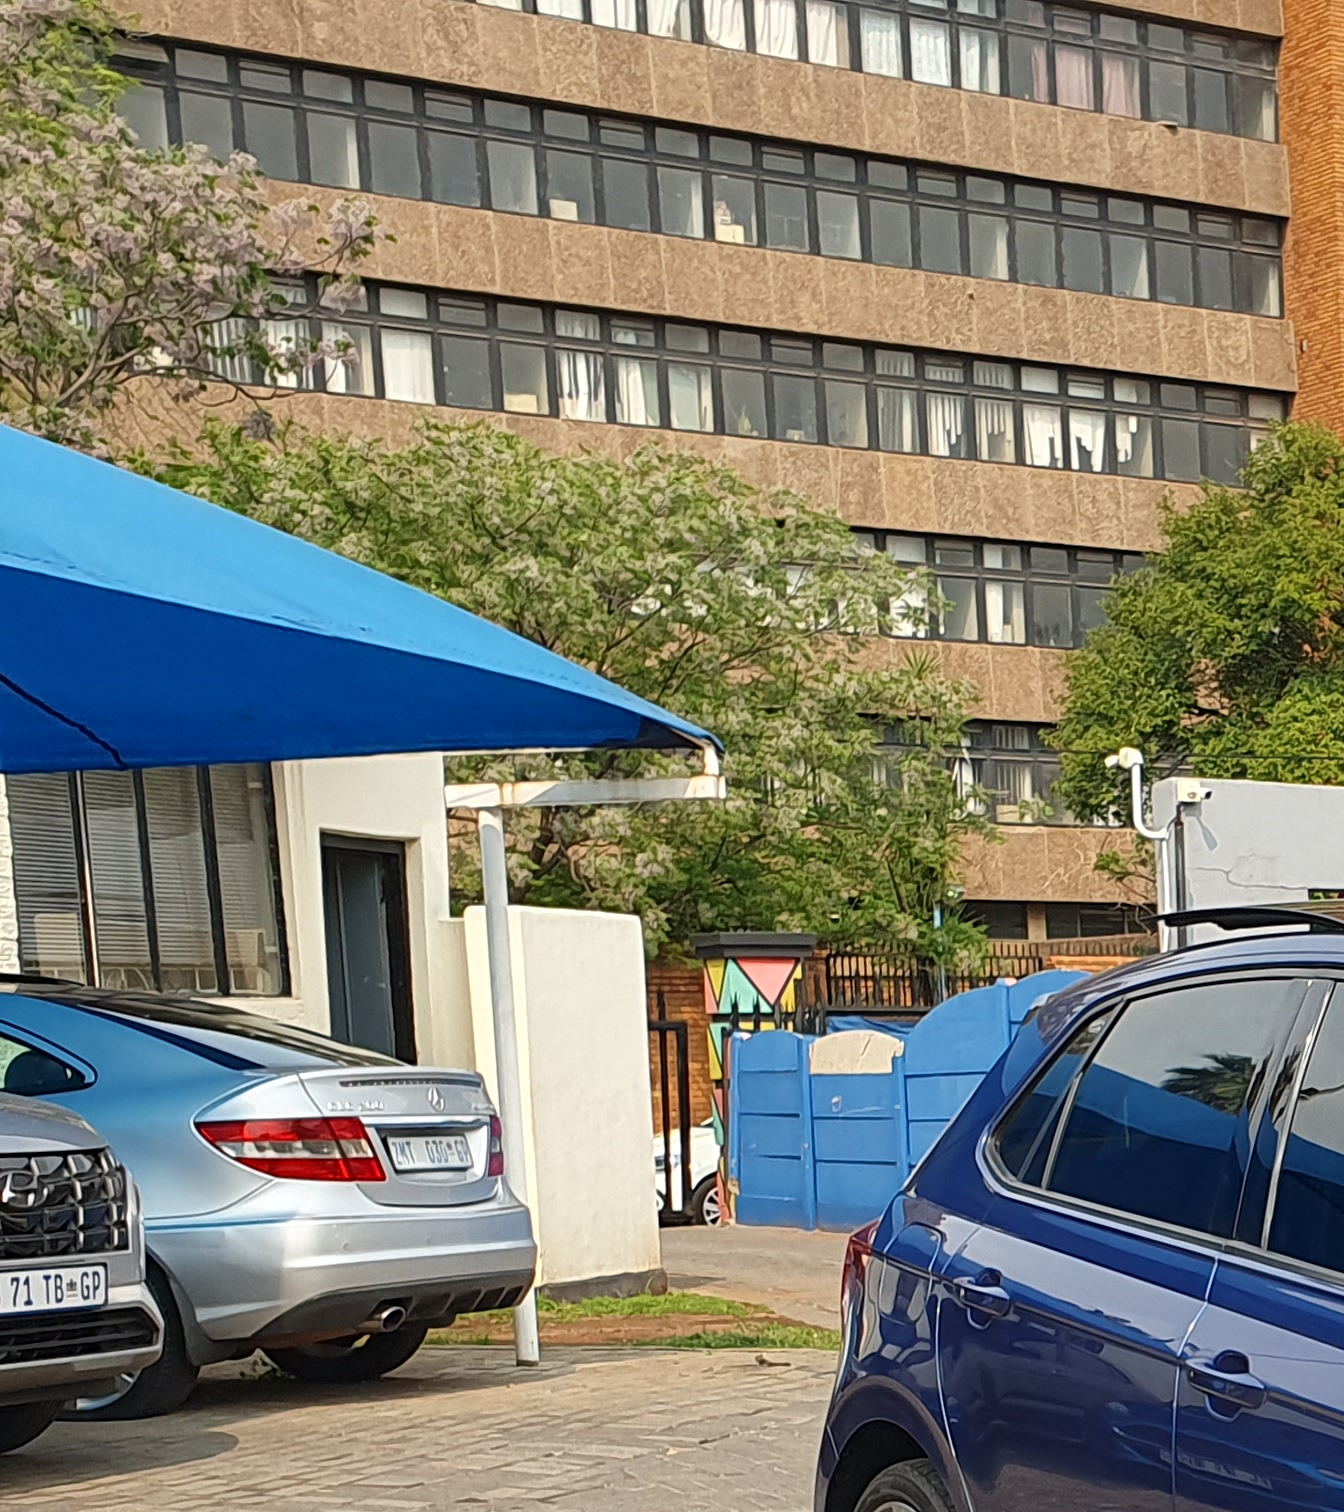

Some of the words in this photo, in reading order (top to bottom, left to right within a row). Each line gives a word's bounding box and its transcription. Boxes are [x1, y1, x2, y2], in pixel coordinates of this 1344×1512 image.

[10, 1276, 33, 1307] 71
[42, 1274, 64, 1304] TB
[80, 1271, 100, 1300] GP
